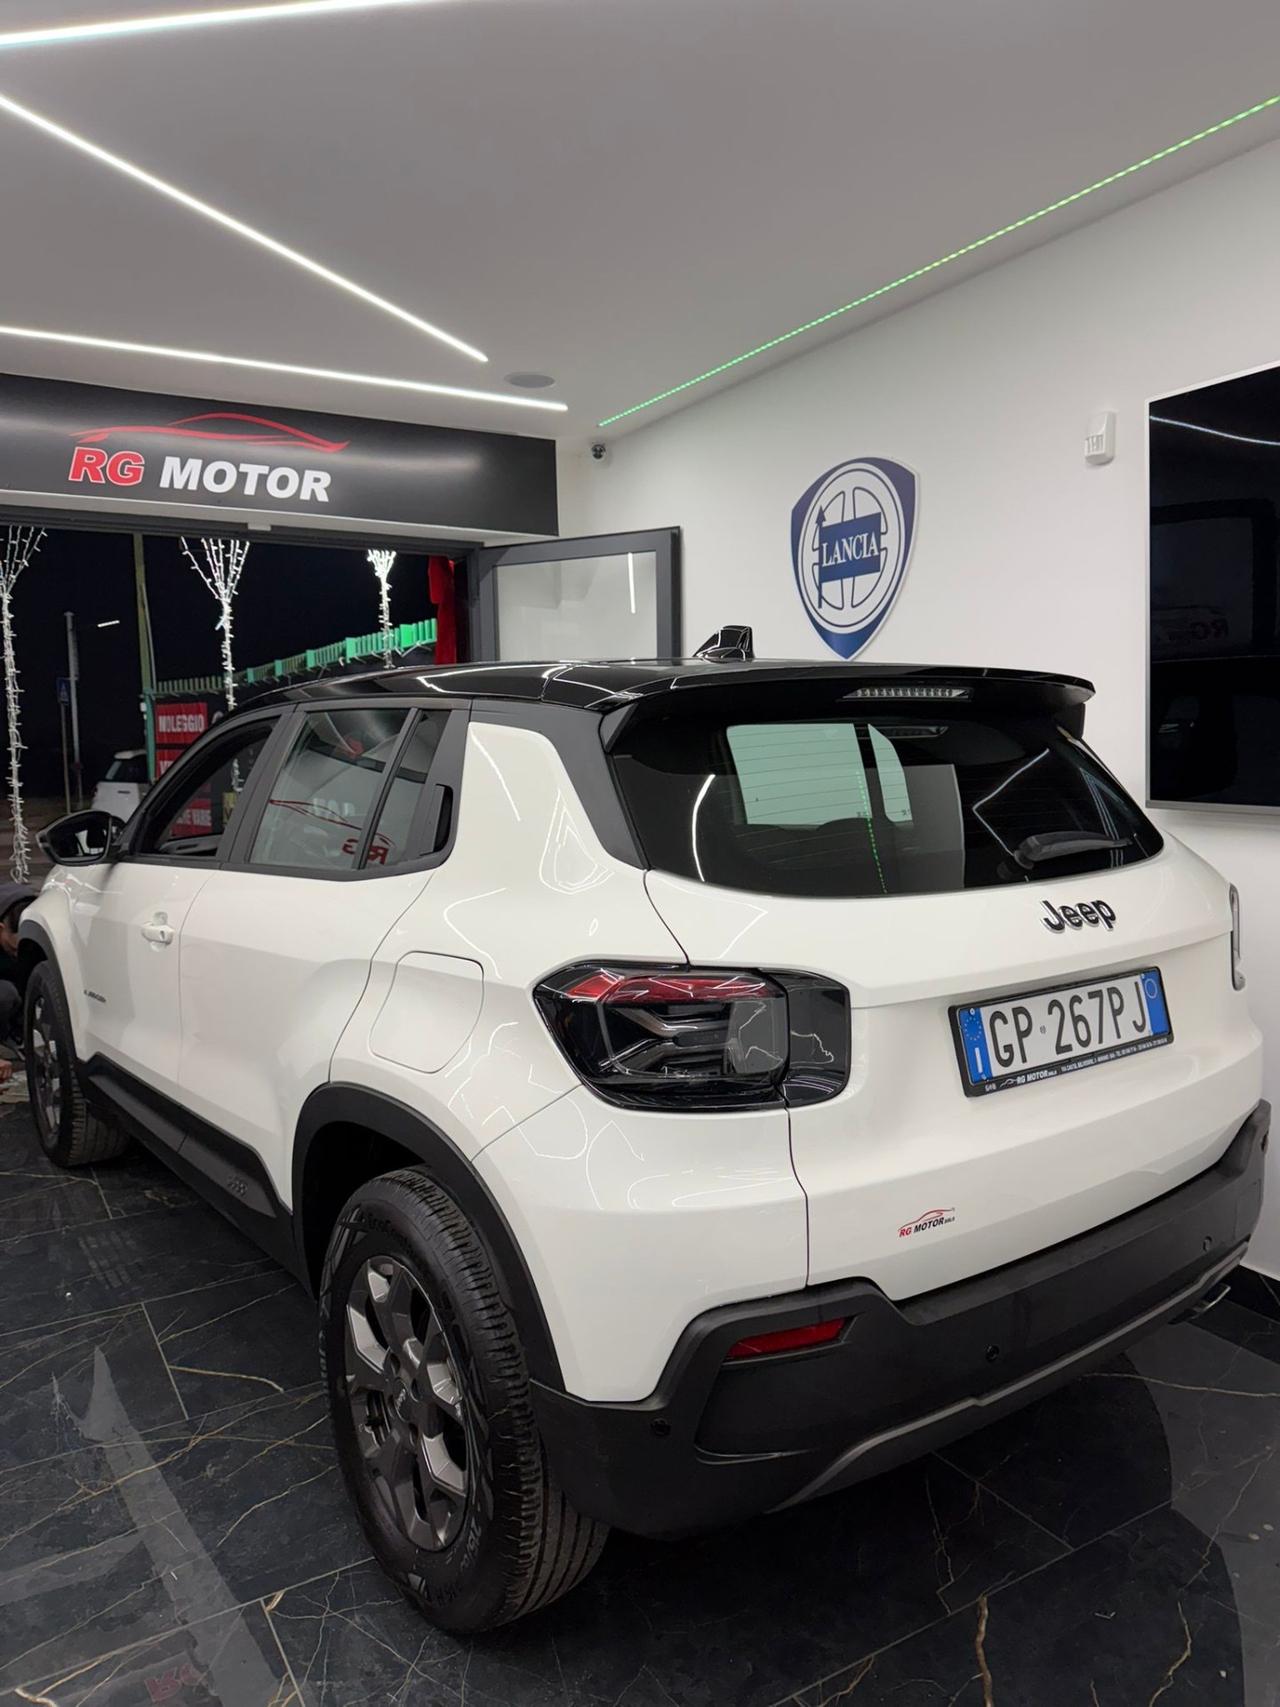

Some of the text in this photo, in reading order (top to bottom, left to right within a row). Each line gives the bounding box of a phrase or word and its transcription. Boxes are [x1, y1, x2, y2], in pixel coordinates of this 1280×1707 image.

[68, 446, 332, 502] RG MOTOR
[821, 531, 879, 568] LANCIA
[1040, 900, 1116, 933] Jeep
[989, 1006, 1033, 1068] GP
[1047, 981, 1147, 1055] 267PJ
[899, 1227, 912, 1238] RG
[913, 1217, 945, 1234] MOTOR
